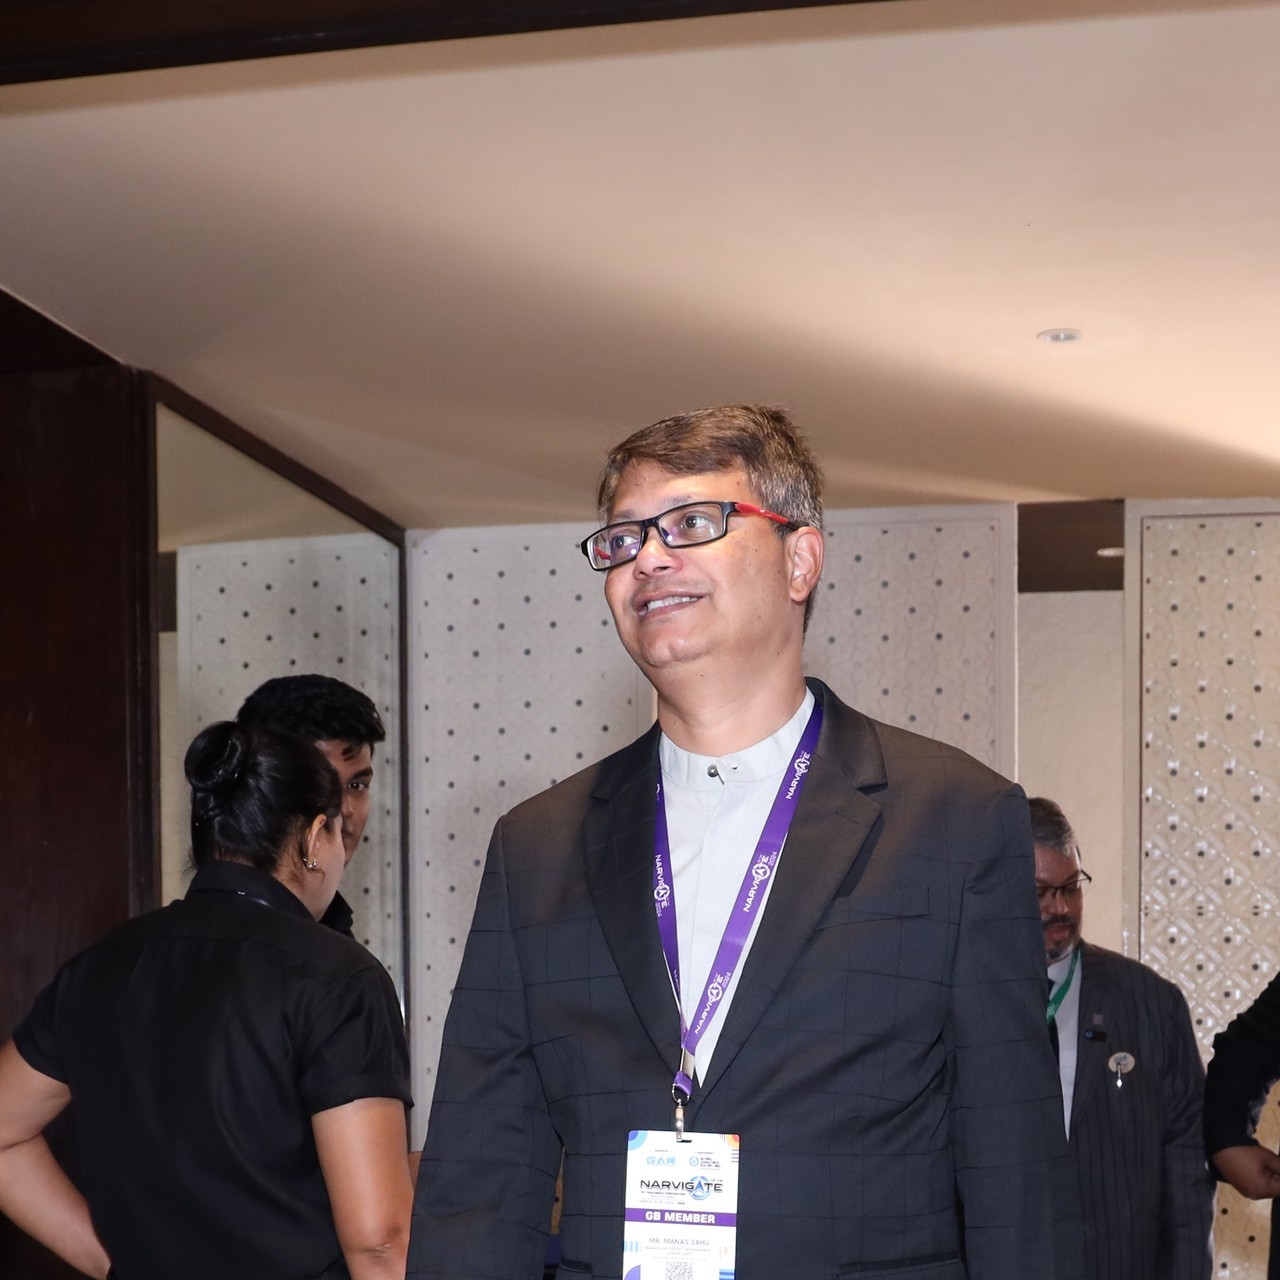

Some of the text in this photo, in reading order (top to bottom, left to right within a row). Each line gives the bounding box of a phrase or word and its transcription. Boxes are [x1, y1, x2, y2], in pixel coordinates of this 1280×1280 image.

[785, 751, 811, 800] NARVIGATE
[768, 850, 778, 866] 2024
[655, 854, 670, 909] NARVIGATE
[742, 854, 770, 913] NARVIGATE
[721, 971, 732, 989] 2024
[694, 974, 723, 1035] NARVIGATE
[640, 1178, 723, 1193] NARVIGATE
[645, 1211, 716, 1224] GB MEMBER
